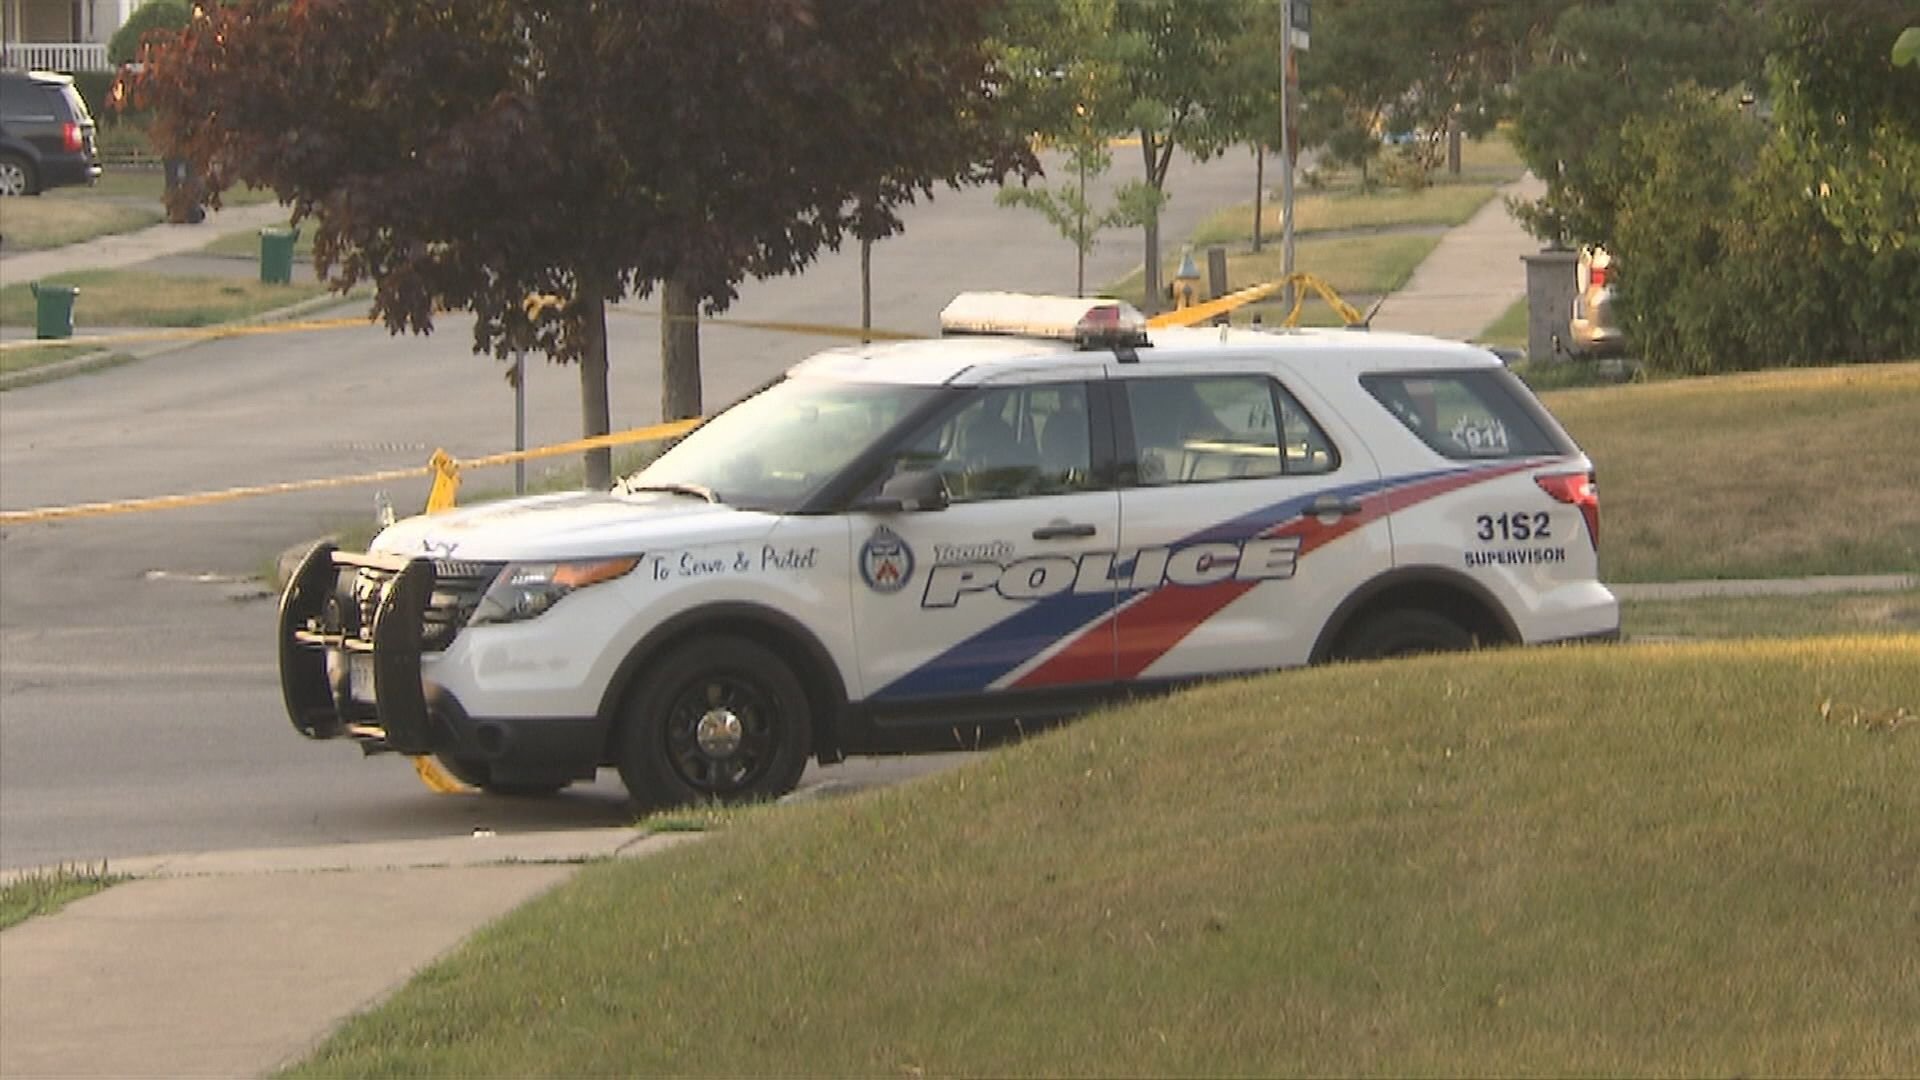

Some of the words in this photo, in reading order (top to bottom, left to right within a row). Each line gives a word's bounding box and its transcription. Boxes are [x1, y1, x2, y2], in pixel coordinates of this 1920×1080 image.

[1477, 511, 1551, 540] 31S2
[653, 556, 669, 580] To
[733, 551, 749, 571] &
[933, 541, 1014, 562] Toronto
[1464, 547, 1566, 567] SUPERVISOR
[921, 536, 1301, 608] POLICE
